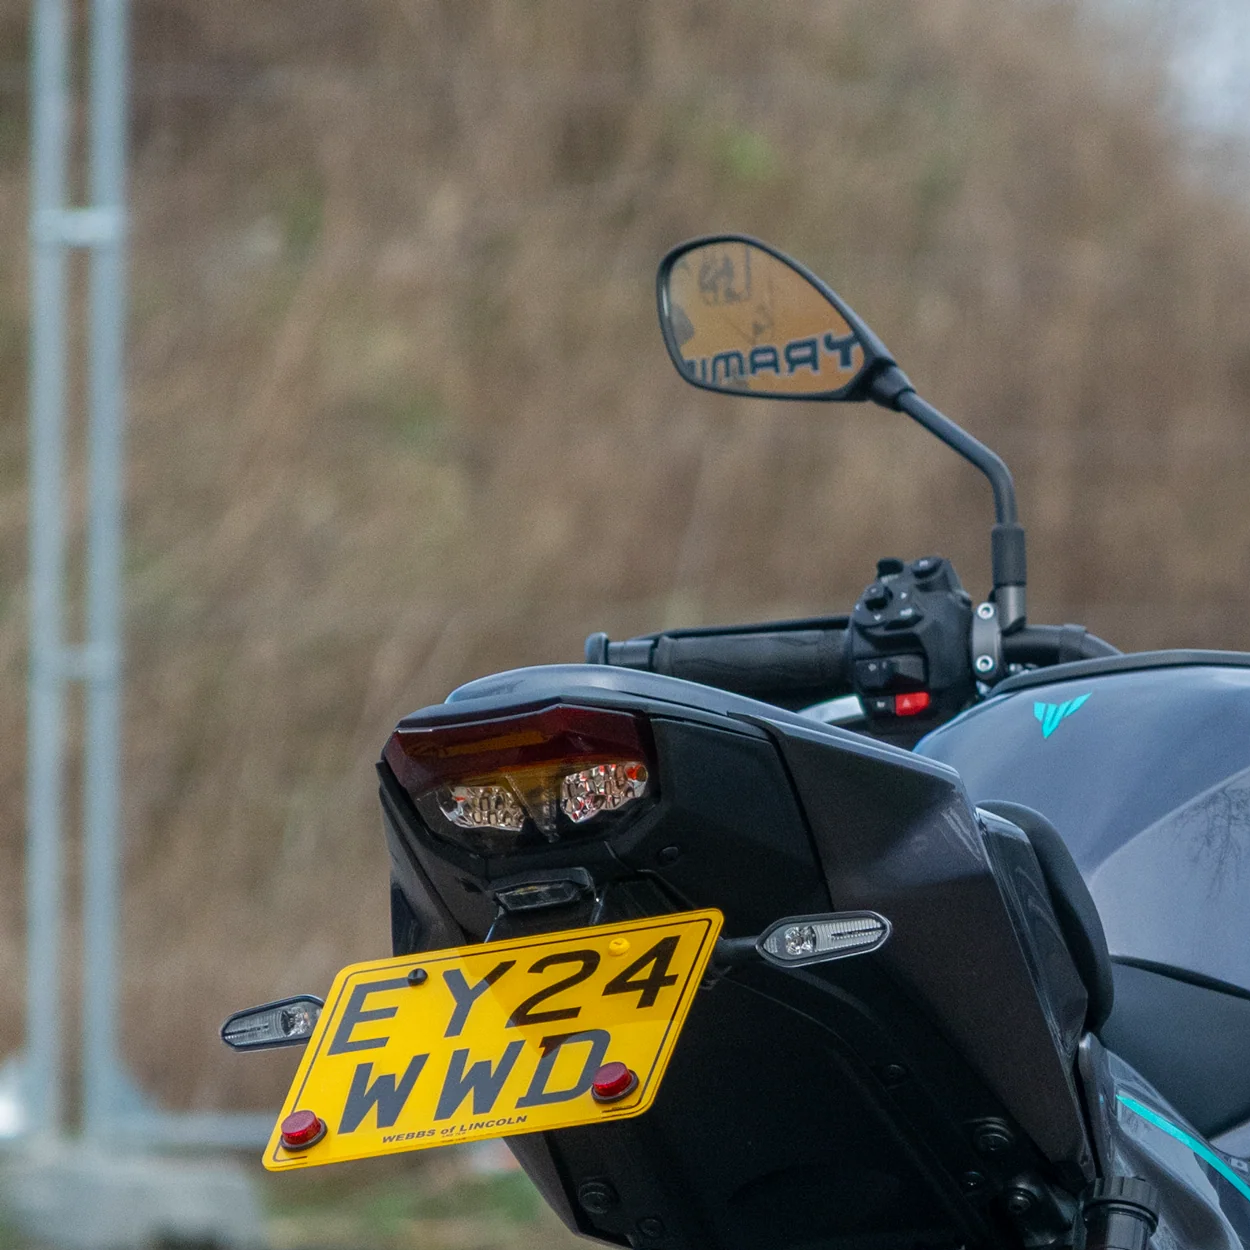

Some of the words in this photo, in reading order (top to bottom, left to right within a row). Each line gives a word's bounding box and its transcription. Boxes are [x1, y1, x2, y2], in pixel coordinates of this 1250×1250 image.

[328, 934, 682, 1056] EY24
[338, 1028, 611, 1135] WWD
[382, 1128, 436, 1144] WEBBS
[440, 1125, 457, 1135] of
[460, 1115, 528, 1132] LINCOLN
